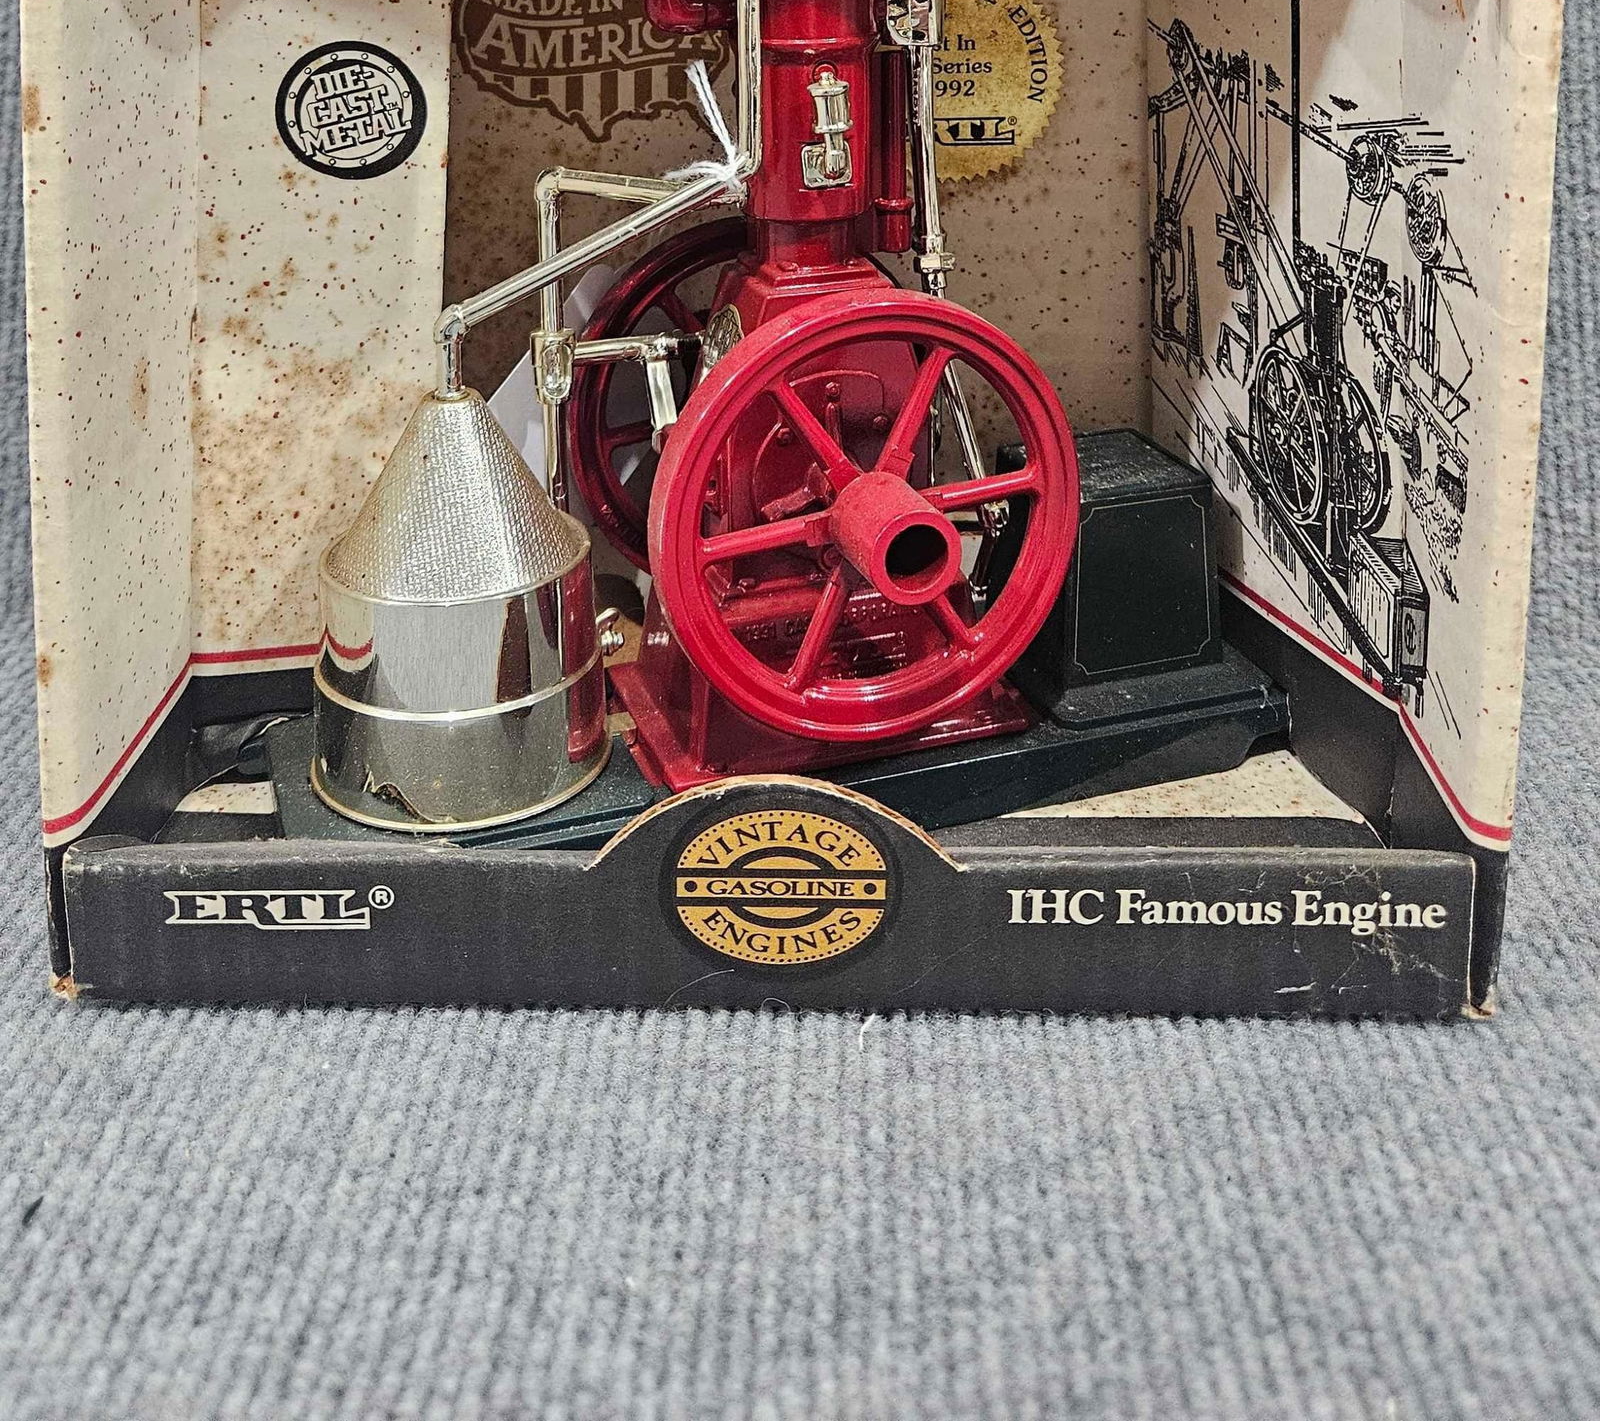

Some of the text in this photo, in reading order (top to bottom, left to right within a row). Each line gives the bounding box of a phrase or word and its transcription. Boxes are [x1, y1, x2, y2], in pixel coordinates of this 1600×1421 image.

[956, 34, 976, 51] In
[1008, 4, 1049, 103] EDITION
[933, 58, 992, 74] Series
[934, 79, 975, 97] 992
[306, 84, 389, 129] CAST
[300, 108, 413, 157] METAL
[696, 820, 861, 868] VINTAGE
[705, 880, 855, 897] GASOLINE
[702, 909, 861, 955] ENGINES
[1007, 889, 1447, 936] IHC Famous Engine
